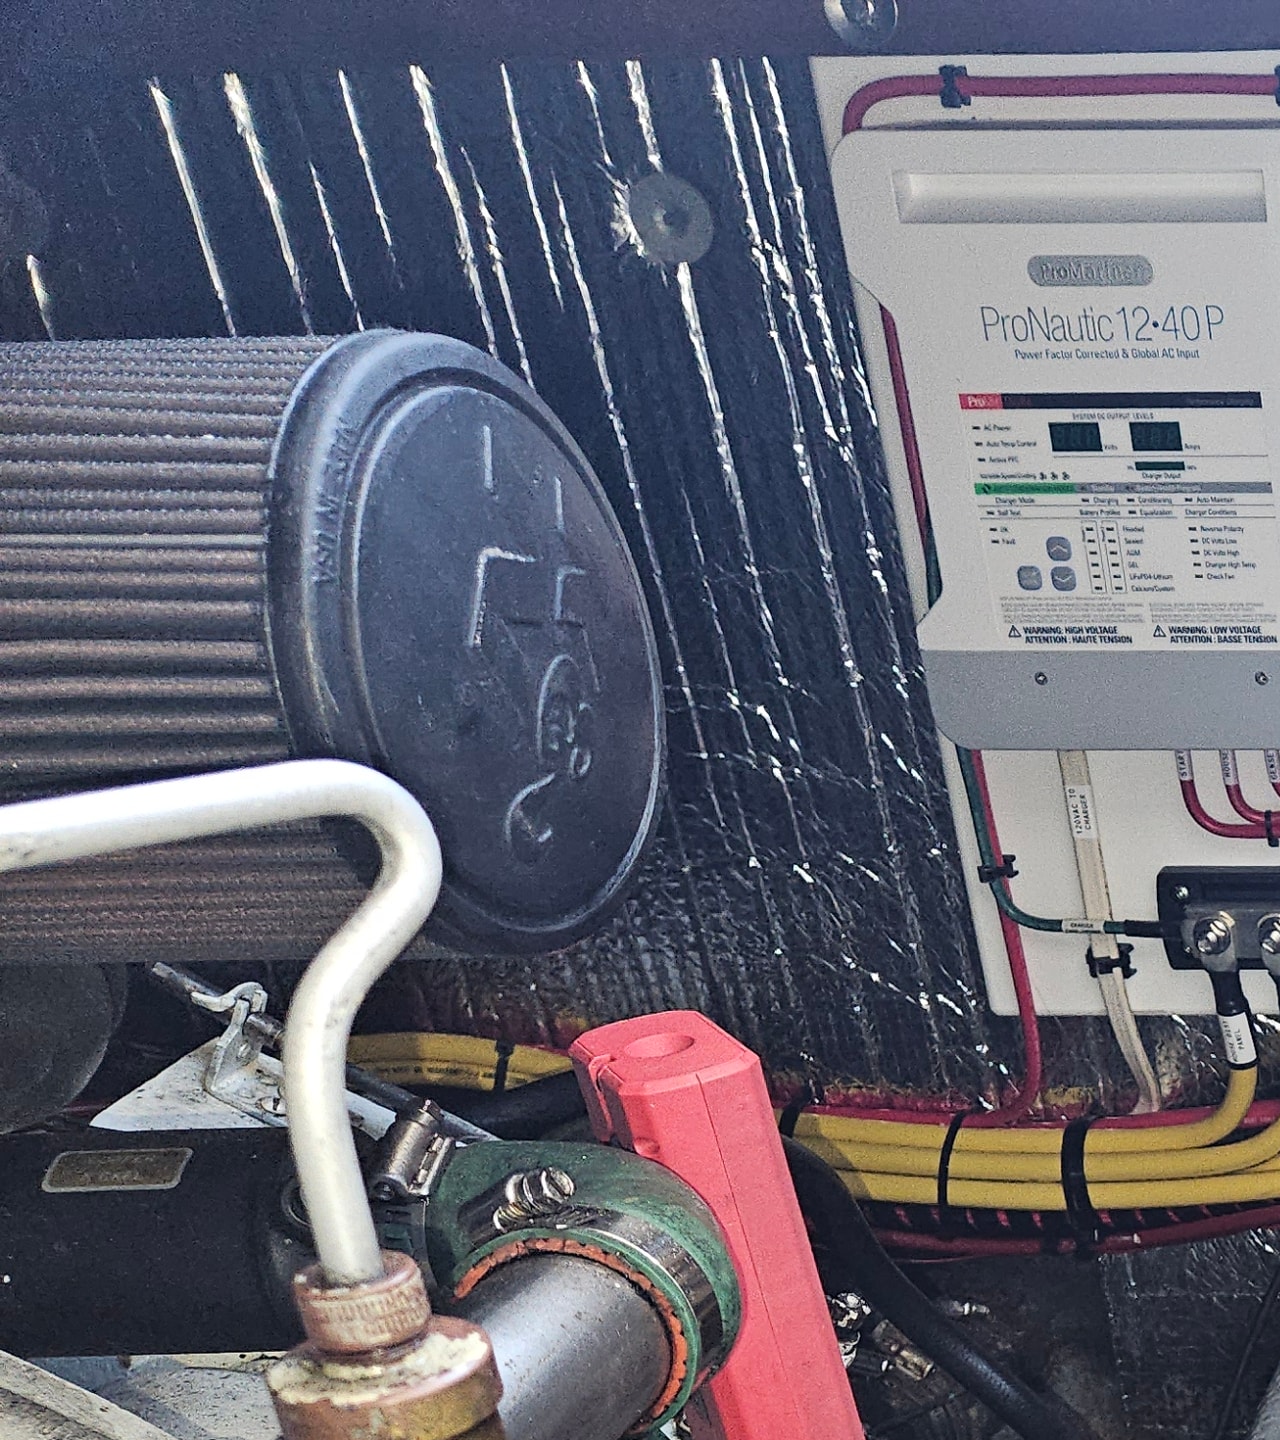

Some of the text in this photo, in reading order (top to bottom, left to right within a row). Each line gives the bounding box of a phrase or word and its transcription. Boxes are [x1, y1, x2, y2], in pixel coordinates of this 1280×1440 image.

[980, 306, 1114, 342] ProNautic
[1014, 348, 1200, 360] Power Factor Corrected & Global AC Input
[1023, 626, 1118, 635] WARNING: HIGH VOLTAGE
[1168, 625, 1262, 634] WARNING: LOW VOLTAGE
[1072, 635, 1097, 644] HAUTE
[1098, 635, 1132, 644] TENSION
[1217, 635, 1242, 644] BASSE
[1244, 635, 1278, 644] TENSION
[1068, 788, 1084, 835] 120VAC TO
[1079, 794, 1092, 831] CHARGER
